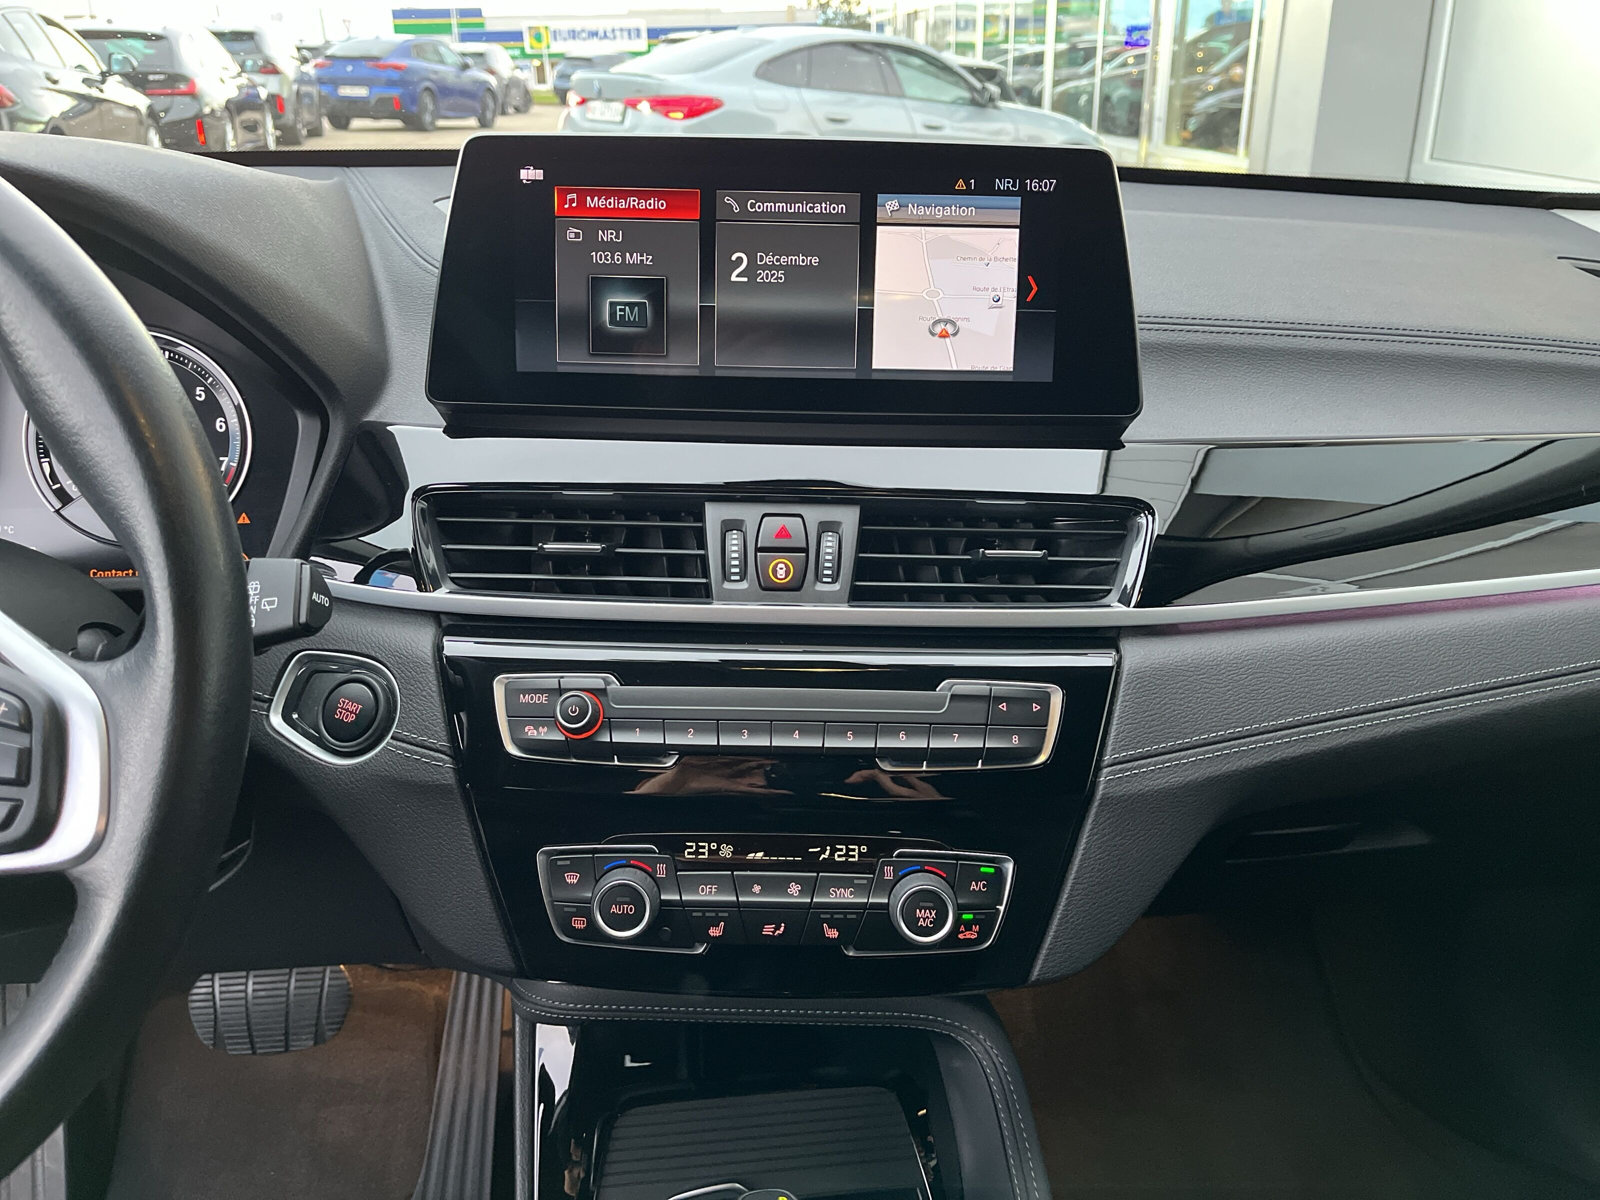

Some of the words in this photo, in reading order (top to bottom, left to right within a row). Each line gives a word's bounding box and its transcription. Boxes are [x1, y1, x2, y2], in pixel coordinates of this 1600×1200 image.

[552, 27, 641, 42] EUROMASTER
[969, 179, 975, 190] 1
[995, 178, 1019, 191] NRJ
[1025, 179, 1057, 192] 16:07
[586, 195, 667, 210] Média/Radio
[747, 200, 846, 215] Communication
[908, 203, 976, 219] Navigation
[598, 230, 623, 242] NRJ
[590, 252, 622, 265] 103.6
[626, 253, 653, 265] MHz
[757, 252, 819, 267] Décembre
[730, 252, 749, 282] 2
[756, 271, 785, 283] 2025
[616, 305, 639, 322] FM
[195, 387, 206, 401] 5
[215, 417, 226, 432] 6
[219, 456, 229, 472] 7
[89, 568, 133, 578] Contact
[311, 591, 330, 607] AUTO
[519, 693, 549, 705] MODE
[337, 697, 363, 714] START
[334, 708, 356, 723] STOP
[635, 727, 640, 737] 1
[687, 728, 694, 738] 2
[741, 729, 748, 739] 3
[793, 730, 799, 739] 4
[847, 731, 853, 741] 5
[899, 731, 906, 741] 6
[952, 733, 959, 743] 7
[1012, 735, 1019, 744] 8
[698, 885, 718, 896] OFF
[970, 881, 987, 892] A/C
[829, 888, 855, 899] SYNC
[610, 904, 635, 915] AUTO
[916, 908, 936, 919] MAX
[918, 918, 934, 928] A/C
[972, 924, 980, 932] M
